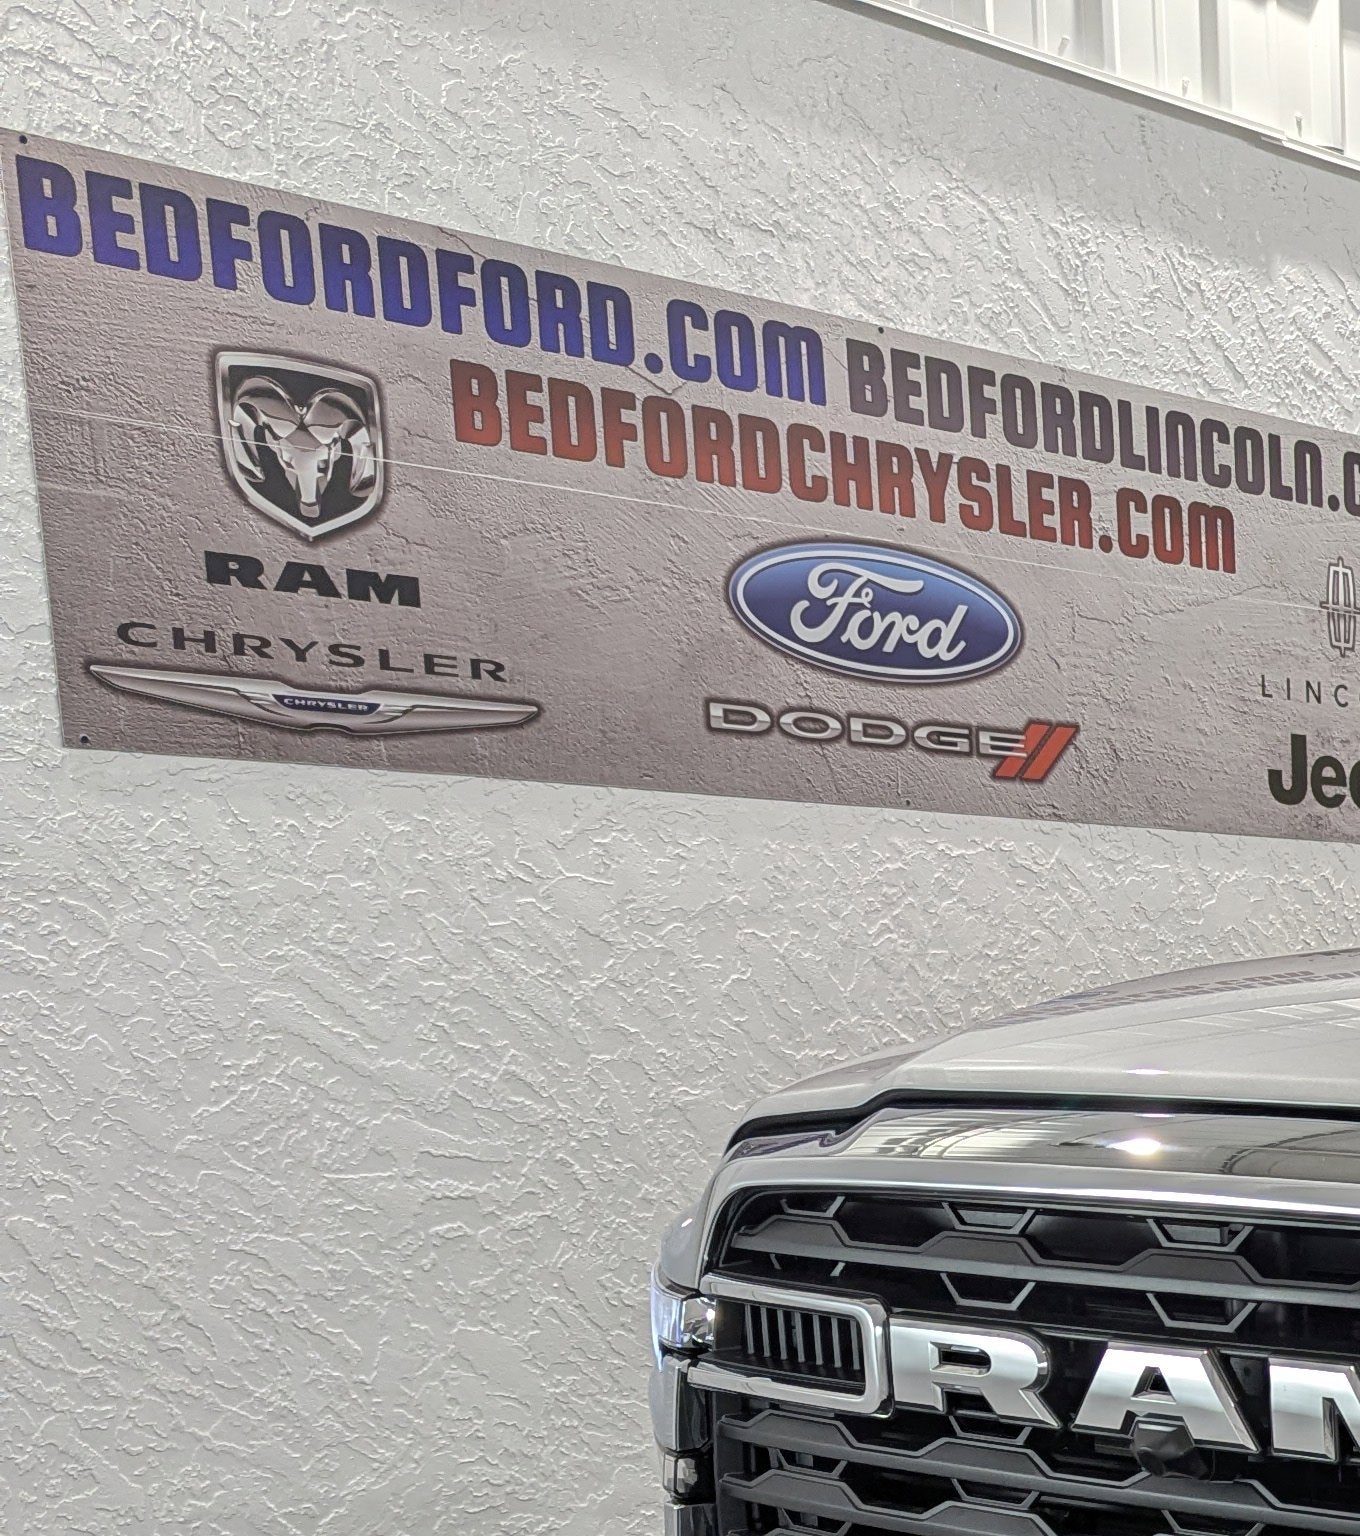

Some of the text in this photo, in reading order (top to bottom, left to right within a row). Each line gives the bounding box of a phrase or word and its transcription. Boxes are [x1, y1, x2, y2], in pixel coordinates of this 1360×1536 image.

[15, 154, 827, 406] BEDFORDFORD.COM
[450, 358, 1237, 575] BEDFORDCHRYSLER.COM
[203, 550, 422, 608] RAM
[790, 562, 971, 662] Ford
[116, 622, 508, 683] CHRYSLER
[283, 698, 369, 711] CHRYSLER
[709, 702, 1028, 758] DODGE
